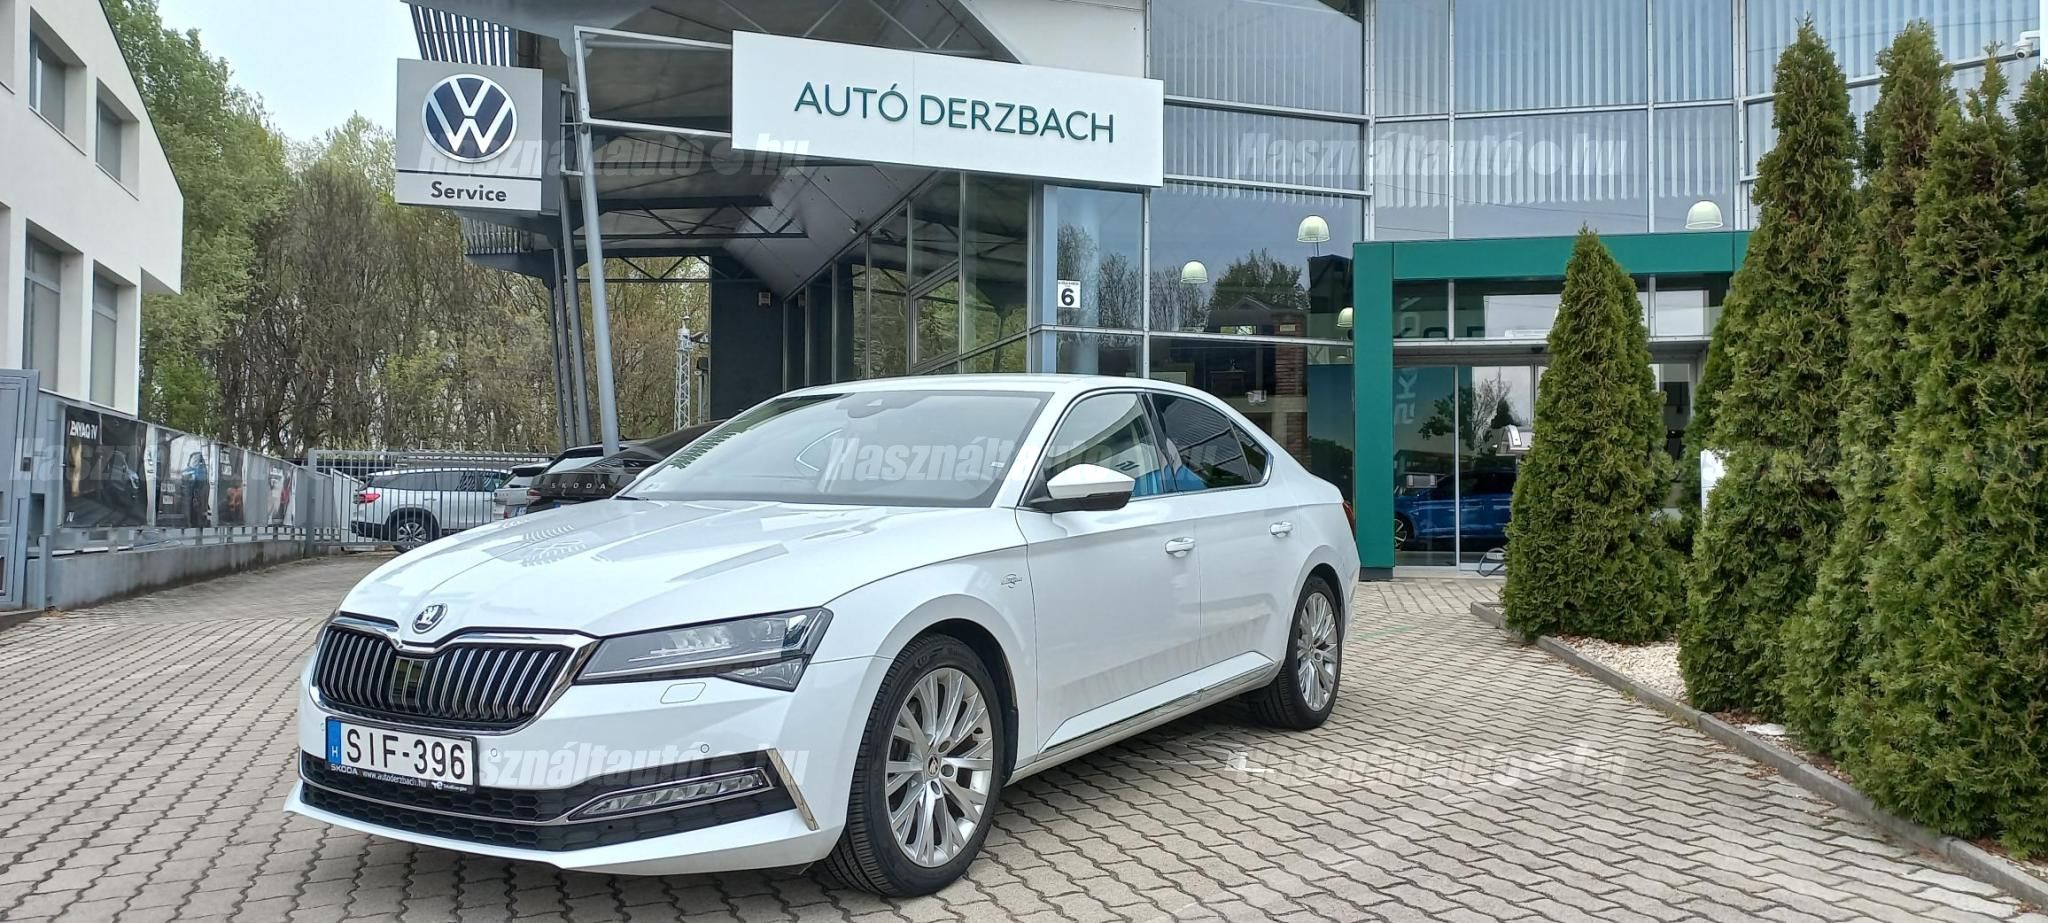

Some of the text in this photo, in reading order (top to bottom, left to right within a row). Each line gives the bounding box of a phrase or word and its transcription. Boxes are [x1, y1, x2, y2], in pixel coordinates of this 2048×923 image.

[794, 81, 1114, 143] AUTÓ DERZBACH
[431, 180, 507, 202] Service
[1061, 287, 1075, 306] 6
[331, 745, 338, 758] H
[346, 728, 465, 780] SIF-396
